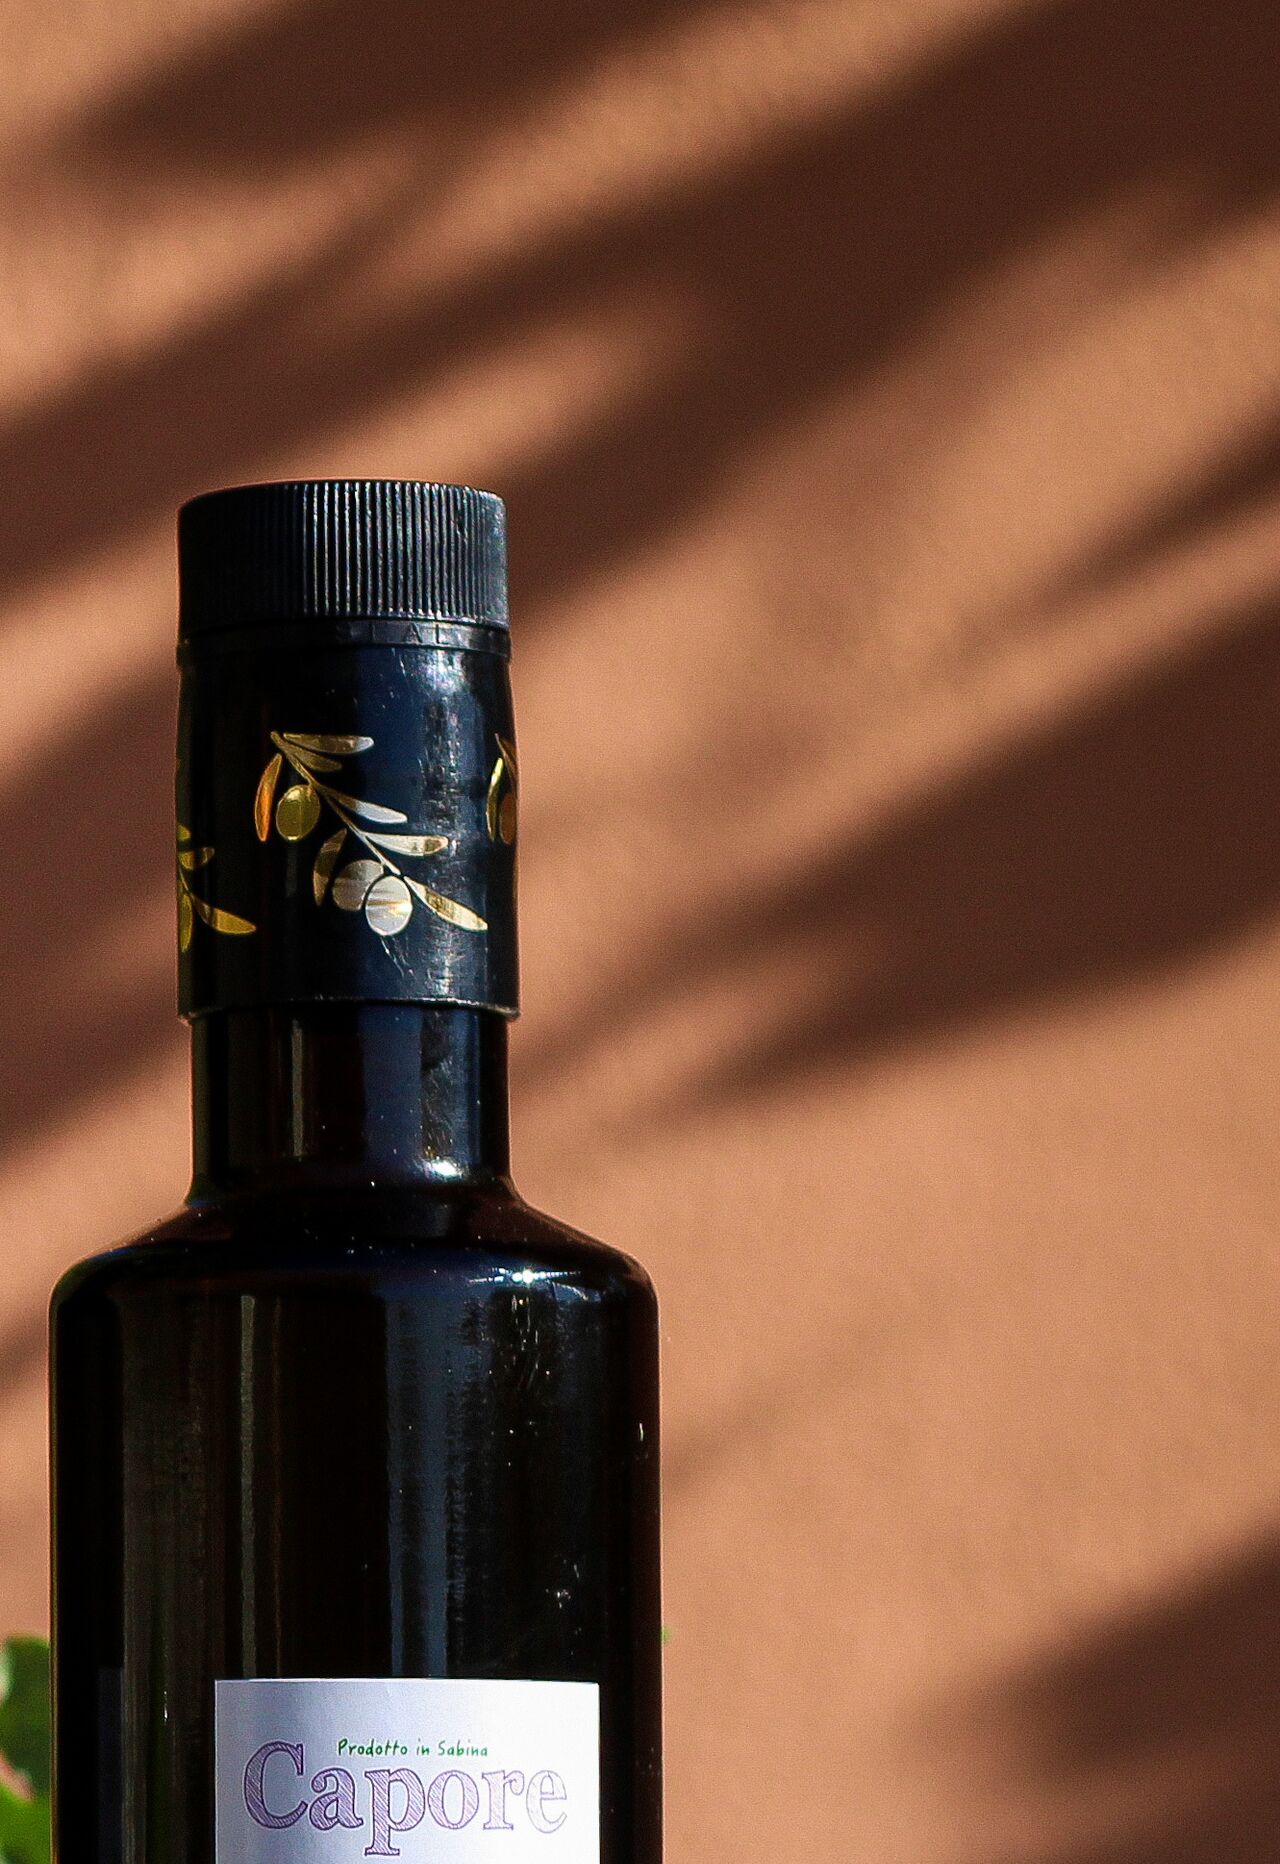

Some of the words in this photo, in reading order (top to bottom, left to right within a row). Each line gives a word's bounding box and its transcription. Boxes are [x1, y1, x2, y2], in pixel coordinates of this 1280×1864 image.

[338, 1738, 409, 1757] Prodotto
[415, 1739, 430, 1757] in
[437, 1740, 488, 1758] Sabina
[242, 1739, 568, 1856] Capore
